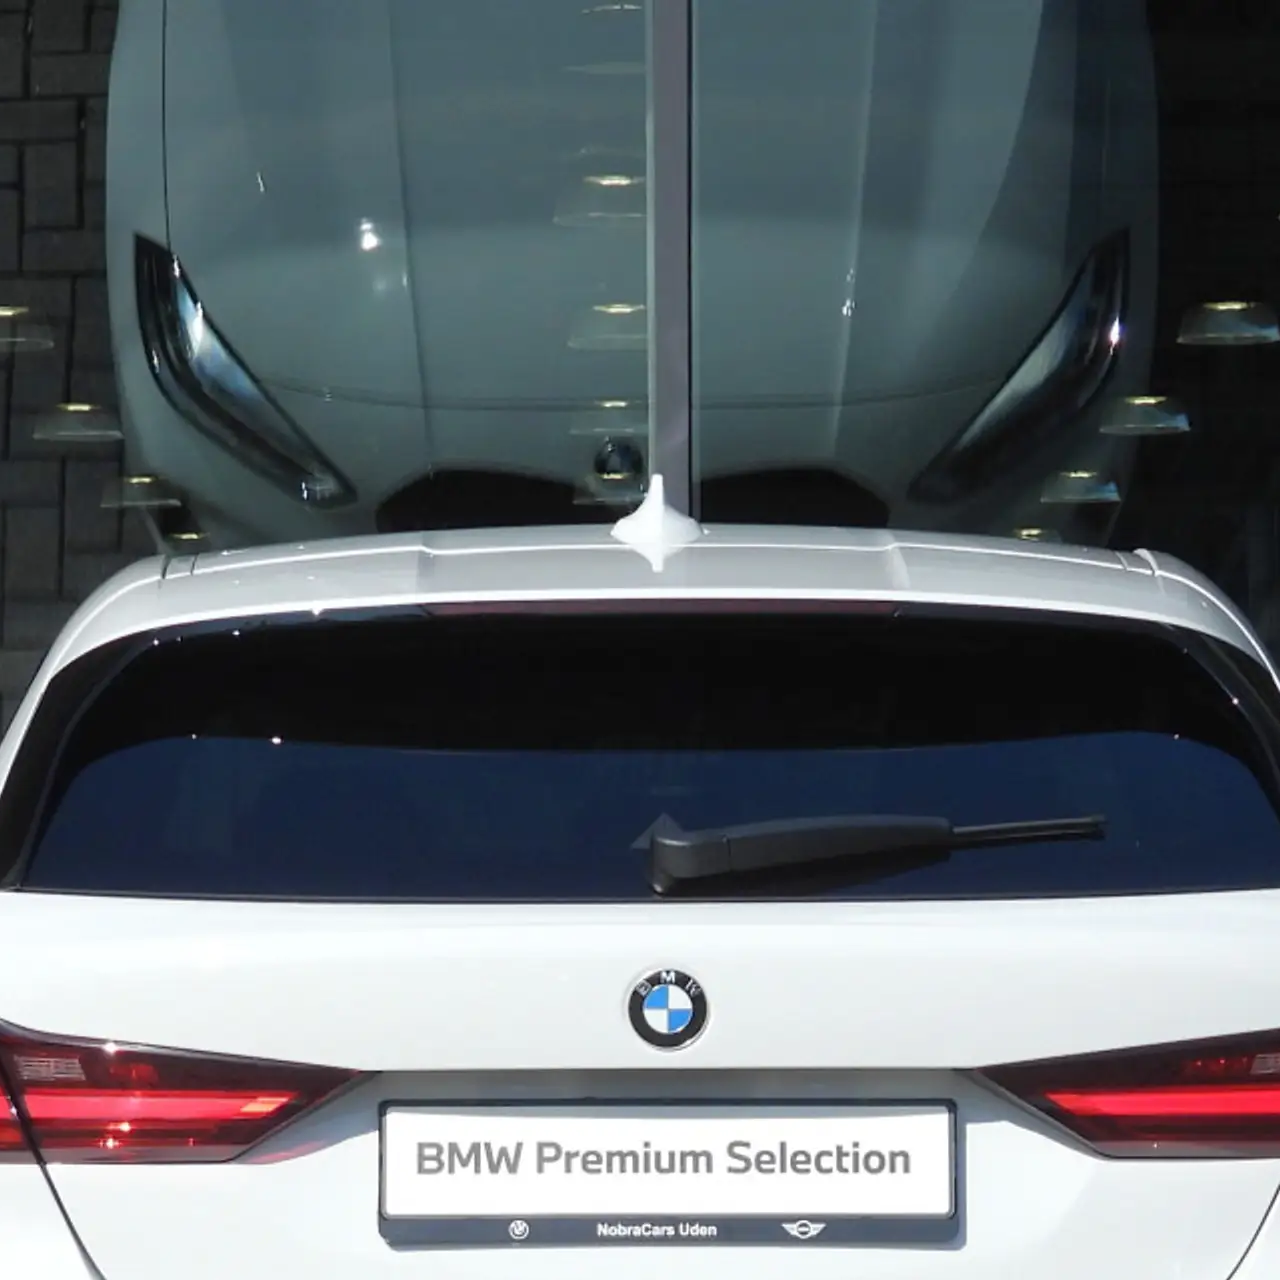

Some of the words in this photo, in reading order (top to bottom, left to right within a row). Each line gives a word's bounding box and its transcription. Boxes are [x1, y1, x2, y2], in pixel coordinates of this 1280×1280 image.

[416, 1141, 524, 1175] BMW
[536, 1141, 714, 1175] Premium
[726, 1140, 911, 1175] Selection
[596, 1221, 676, 1237] NobraCars
[678, 1221, 718, 1237] Uden
